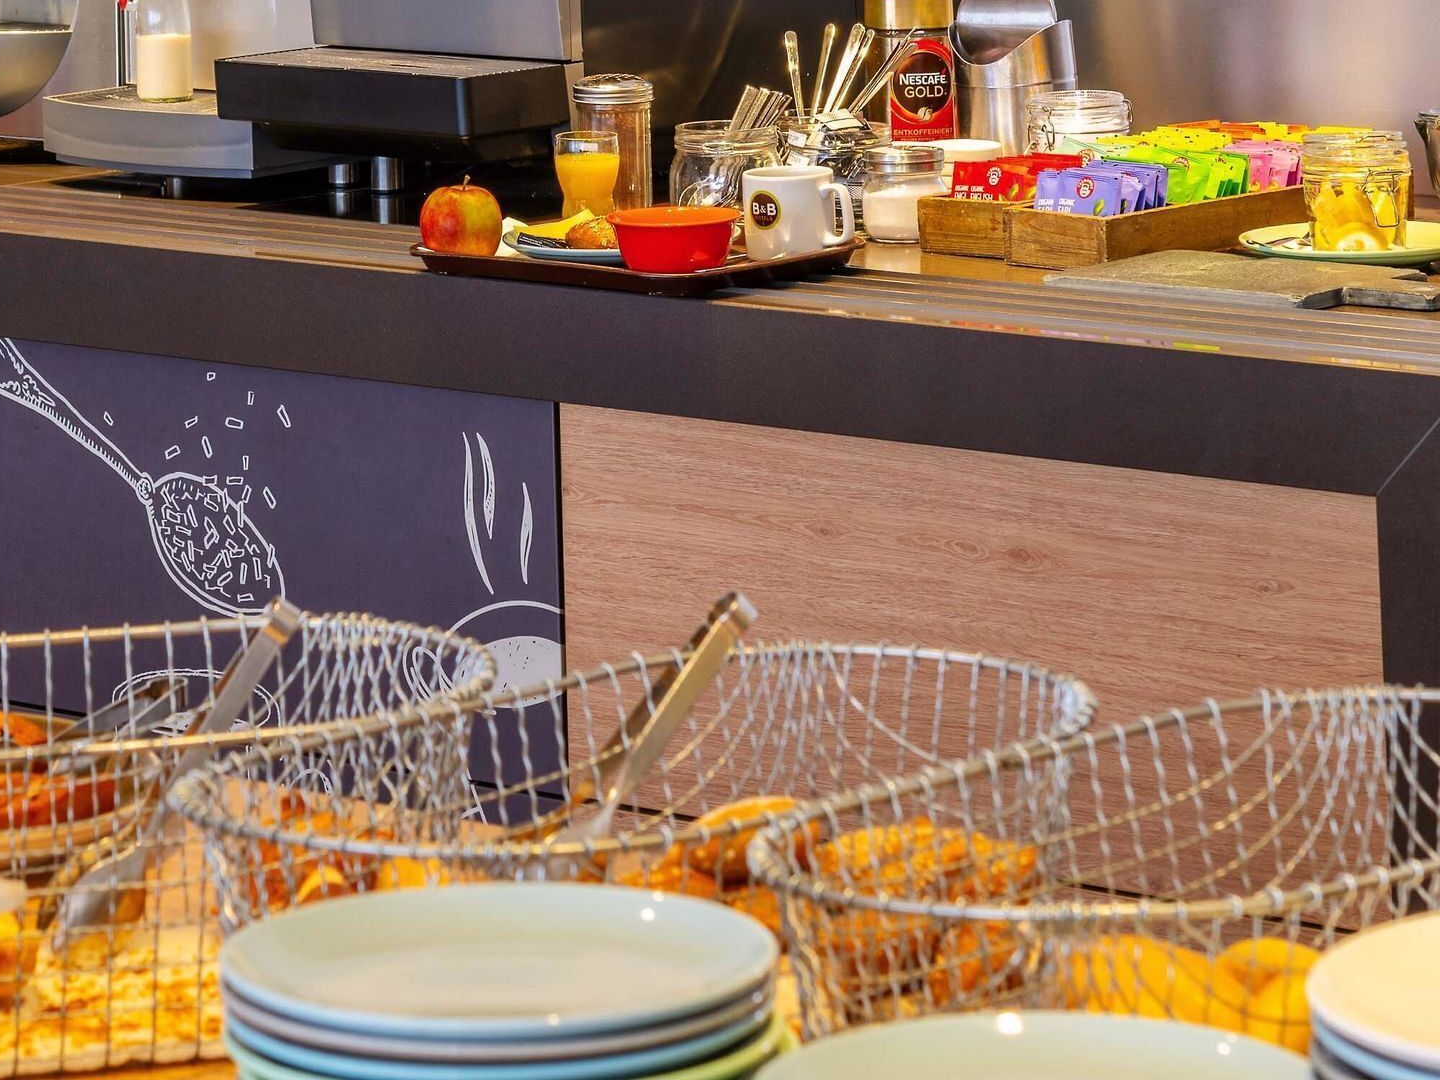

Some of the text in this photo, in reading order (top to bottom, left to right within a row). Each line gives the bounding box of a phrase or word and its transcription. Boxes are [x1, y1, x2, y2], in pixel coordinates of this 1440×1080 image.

[904, 85, 944, 98] GOLD
[893, 127, 953, 136] ENTKOFFEINIERT
[752, 202, 777, 216] B&B
